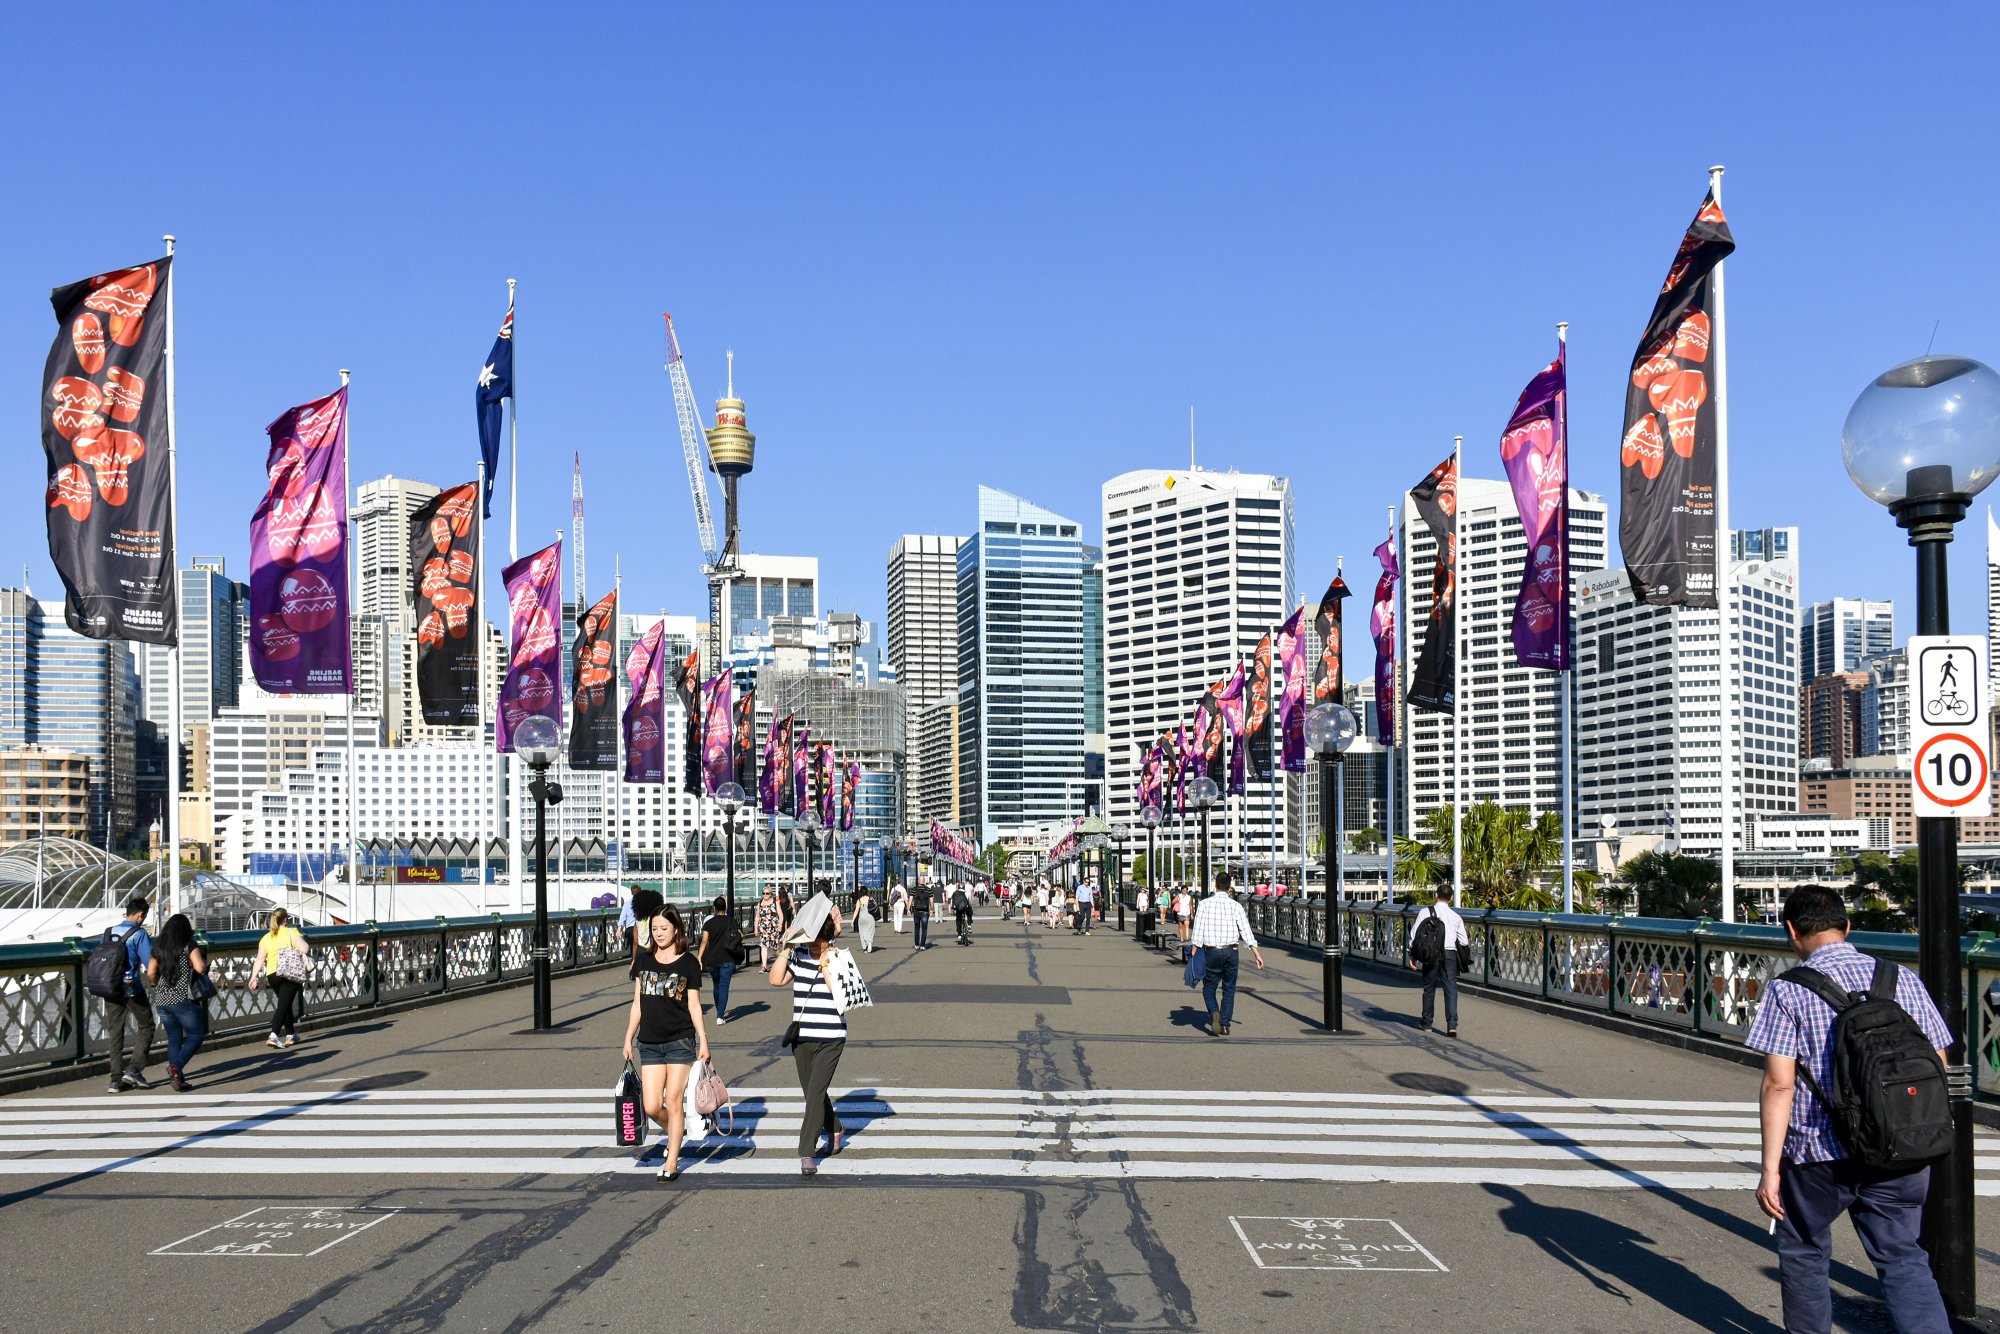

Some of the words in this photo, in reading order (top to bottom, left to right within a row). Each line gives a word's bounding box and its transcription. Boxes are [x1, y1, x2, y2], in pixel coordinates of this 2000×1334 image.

[1591, 576, 1621, 592] Rabobank
[1928, 753, 1972, 787] 10
[624, 1102, 636, 1142] CAMPER
[255, 1231, 293, 1239] TO
[1305, 1233, 1350, 1241] TO
[1256, 1242, 1327, 1250] WAY
[1338, 1242, 1417, 1252] GIVE
